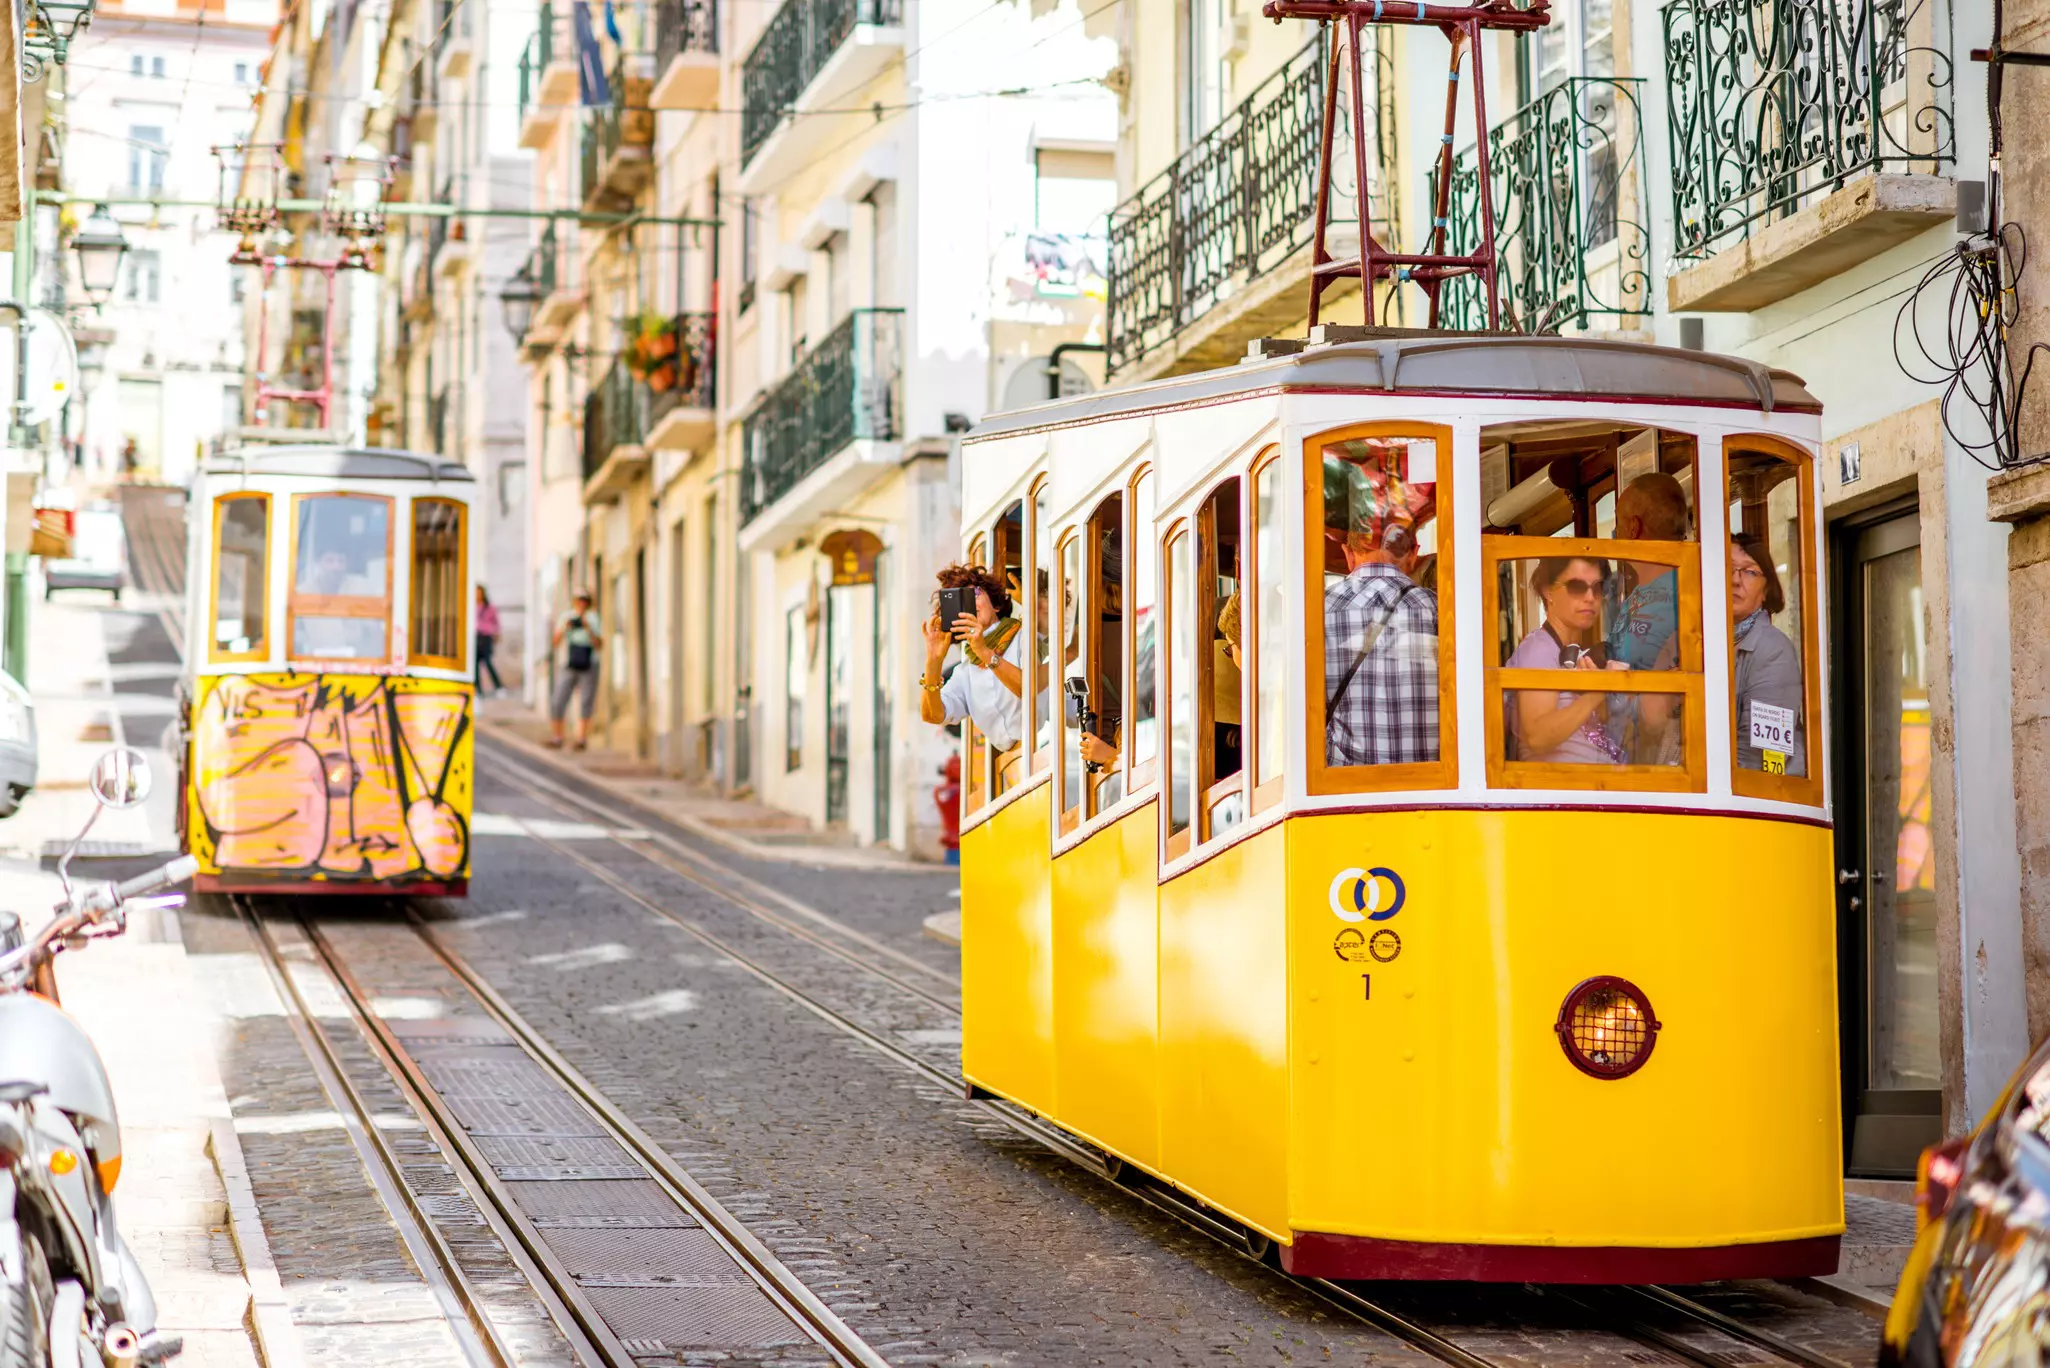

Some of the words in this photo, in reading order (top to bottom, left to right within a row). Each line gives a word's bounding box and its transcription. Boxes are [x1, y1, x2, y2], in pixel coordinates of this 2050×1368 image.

[1753, 723, 1780, 741] 3.70
[1784, 730, 1792, 744] €
[1762, 760, 1783, 775] 3.70
[1361, 973, 1370, 1001] 1
